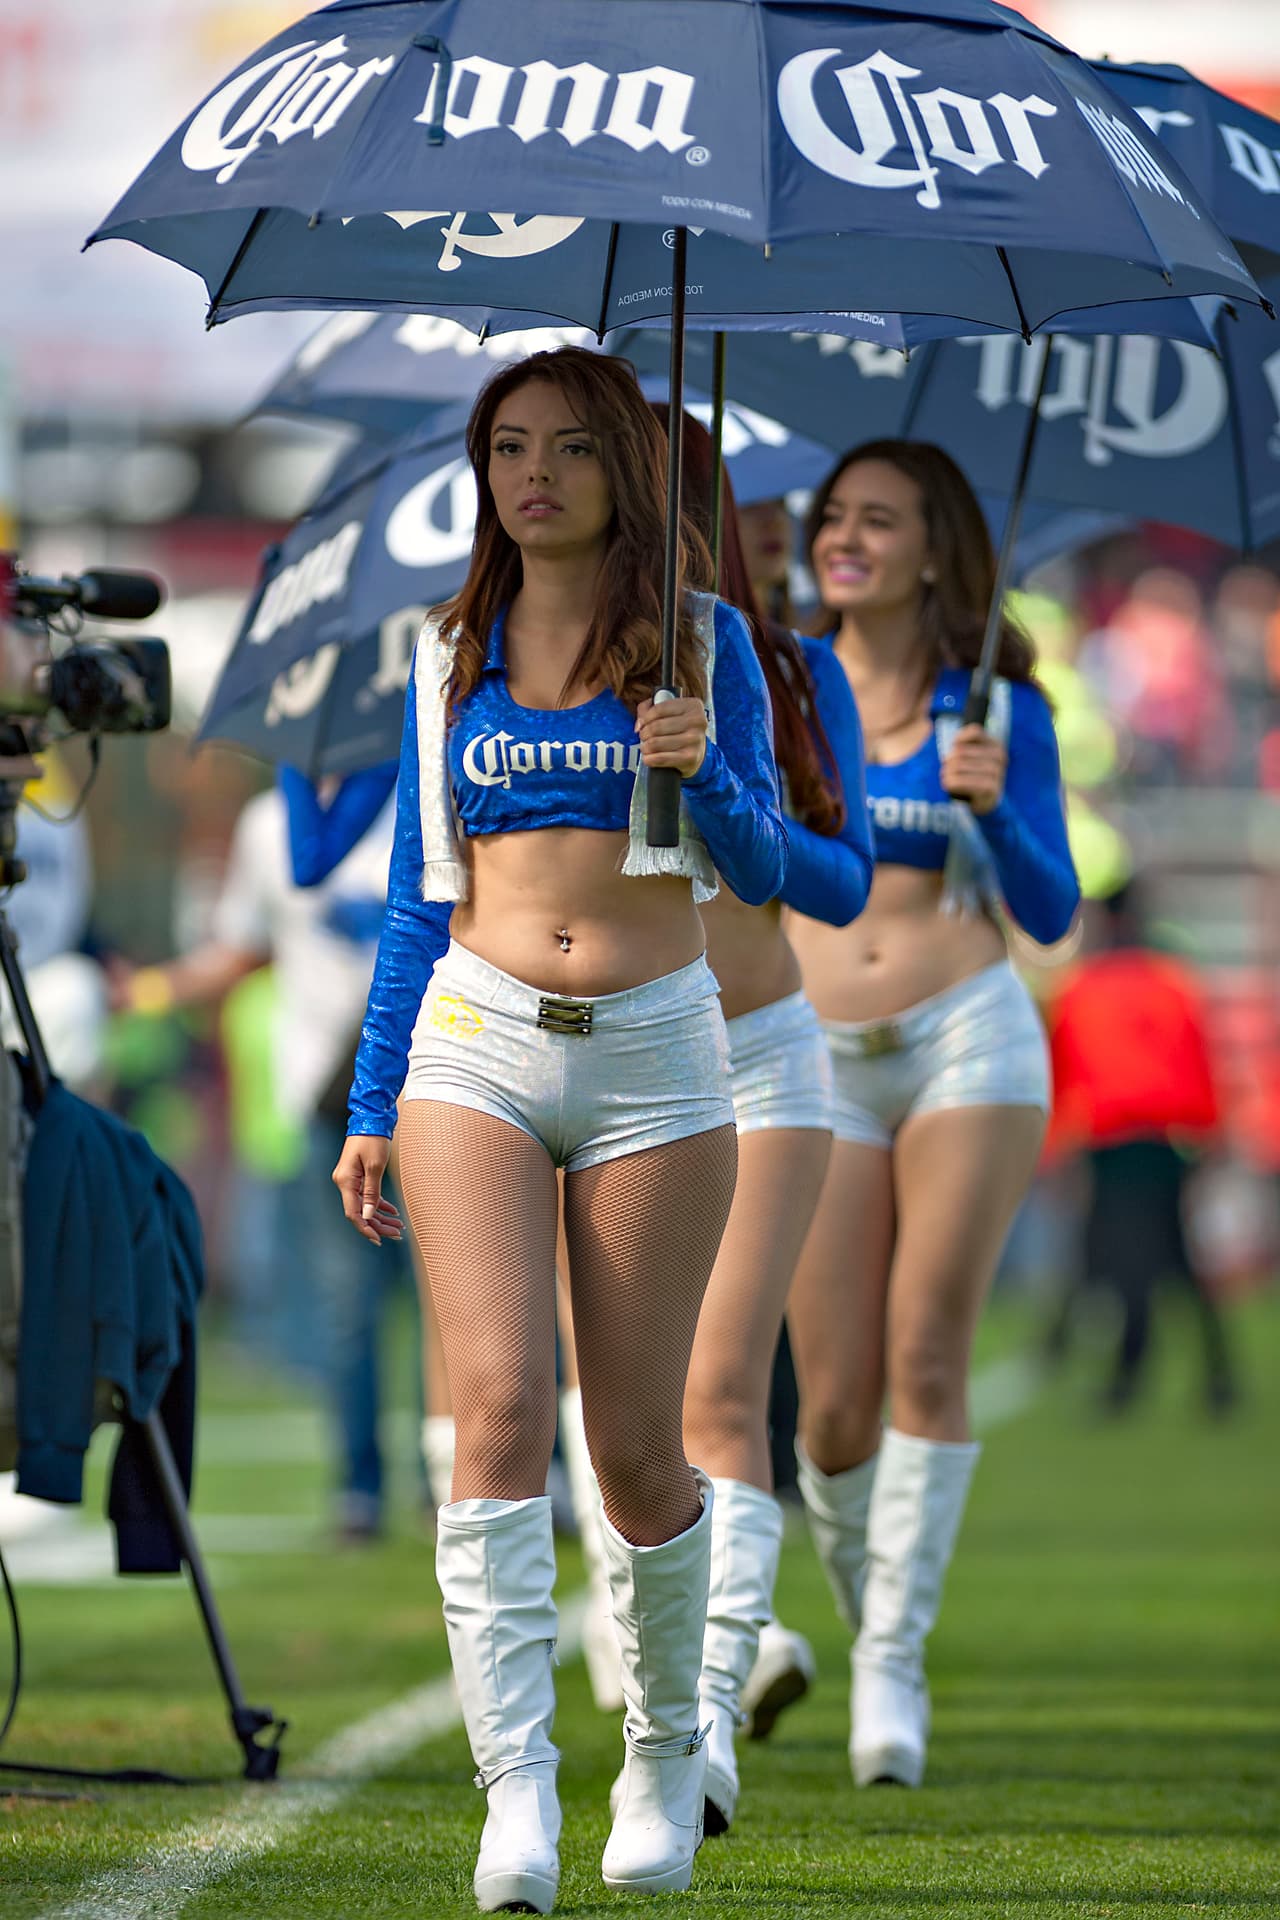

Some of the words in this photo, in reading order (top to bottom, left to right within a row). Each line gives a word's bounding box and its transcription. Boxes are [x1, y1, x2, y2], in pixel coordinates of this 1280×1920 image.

[662, 195, 689, 207] TODO
[691, 198, 713, 210] CON
[714, 202, 752, 219] MEDIDA
